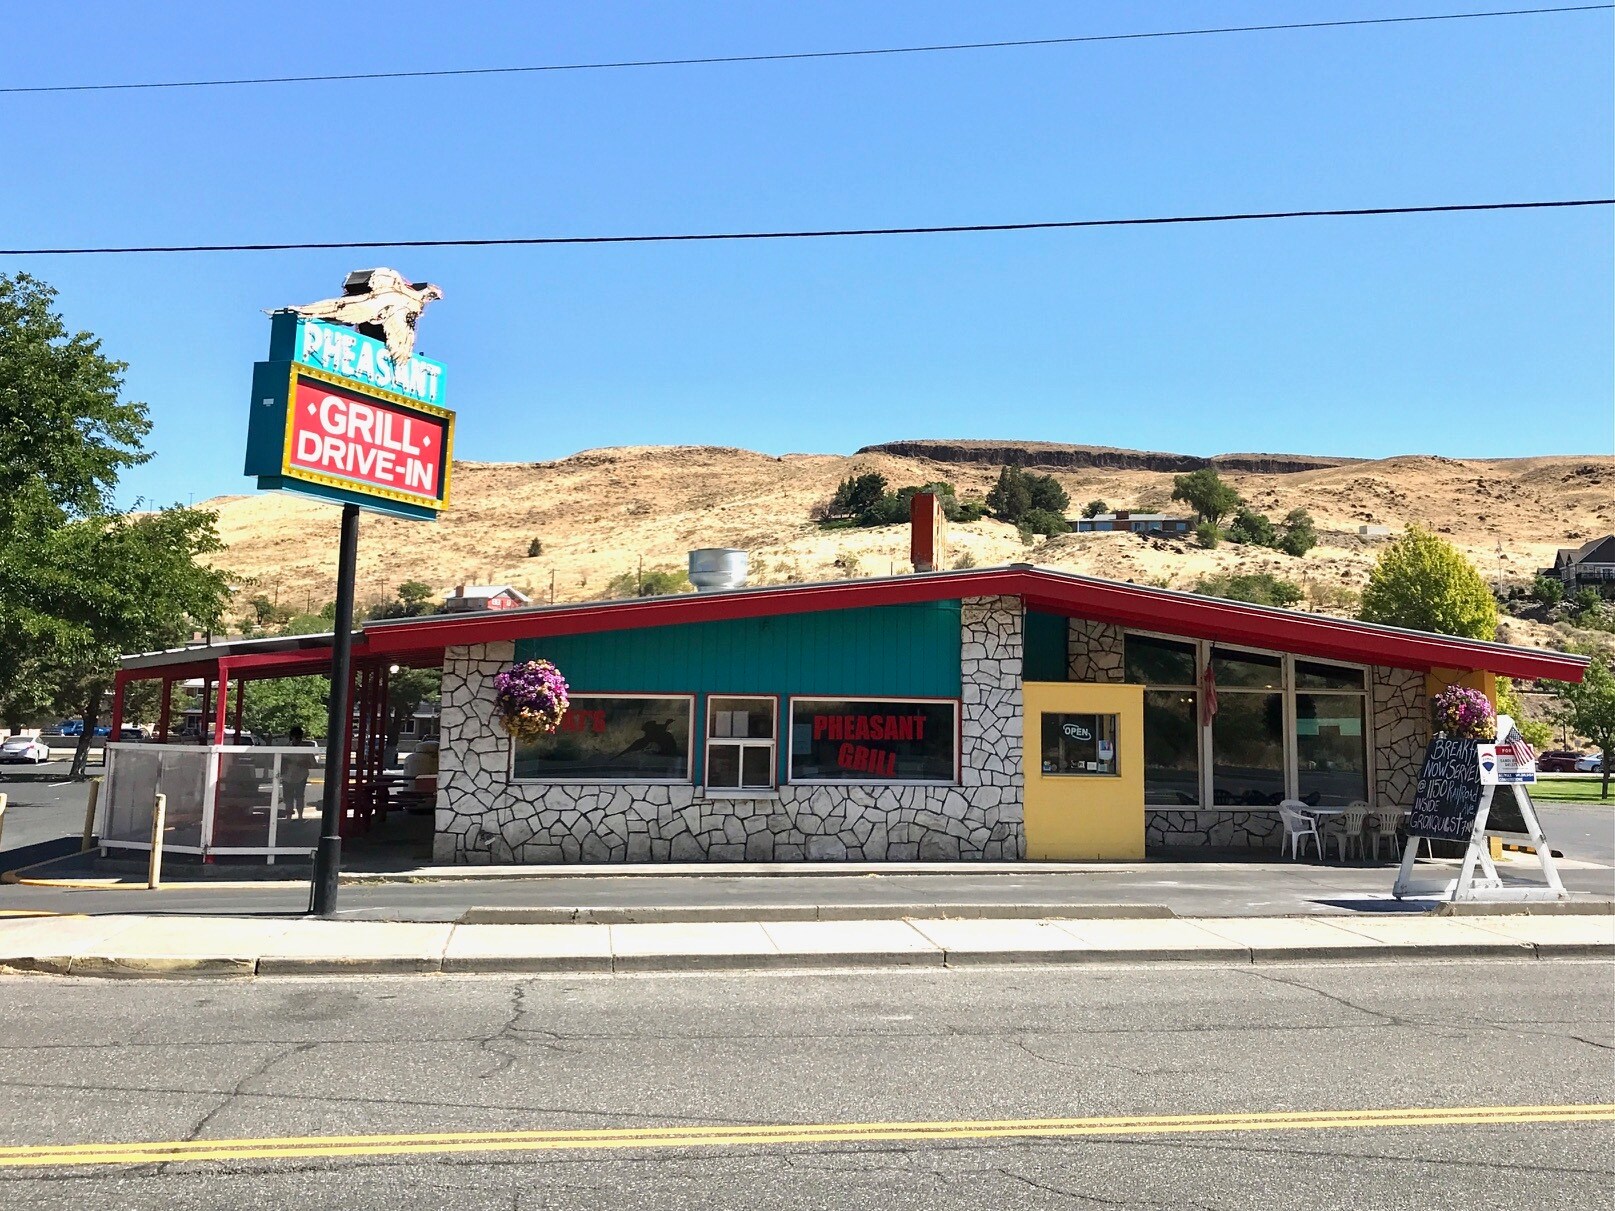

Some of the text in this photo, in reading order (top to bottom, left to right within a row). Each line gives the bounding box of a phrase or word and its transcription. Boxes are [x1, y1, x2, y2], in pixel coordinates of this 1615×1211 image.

[302, 321, 441, 399] PHEASANT
[319, 395, 420, 455] GRILL
[296, 430, 433, 490] DRIVE-IN
[813, 715, 927, 740] PHEASANT
[1064, 726, 1089, 737] OPEN
[838, 742, 897, 778] GRILL
[1423, 760, 1449, 778] NOW
